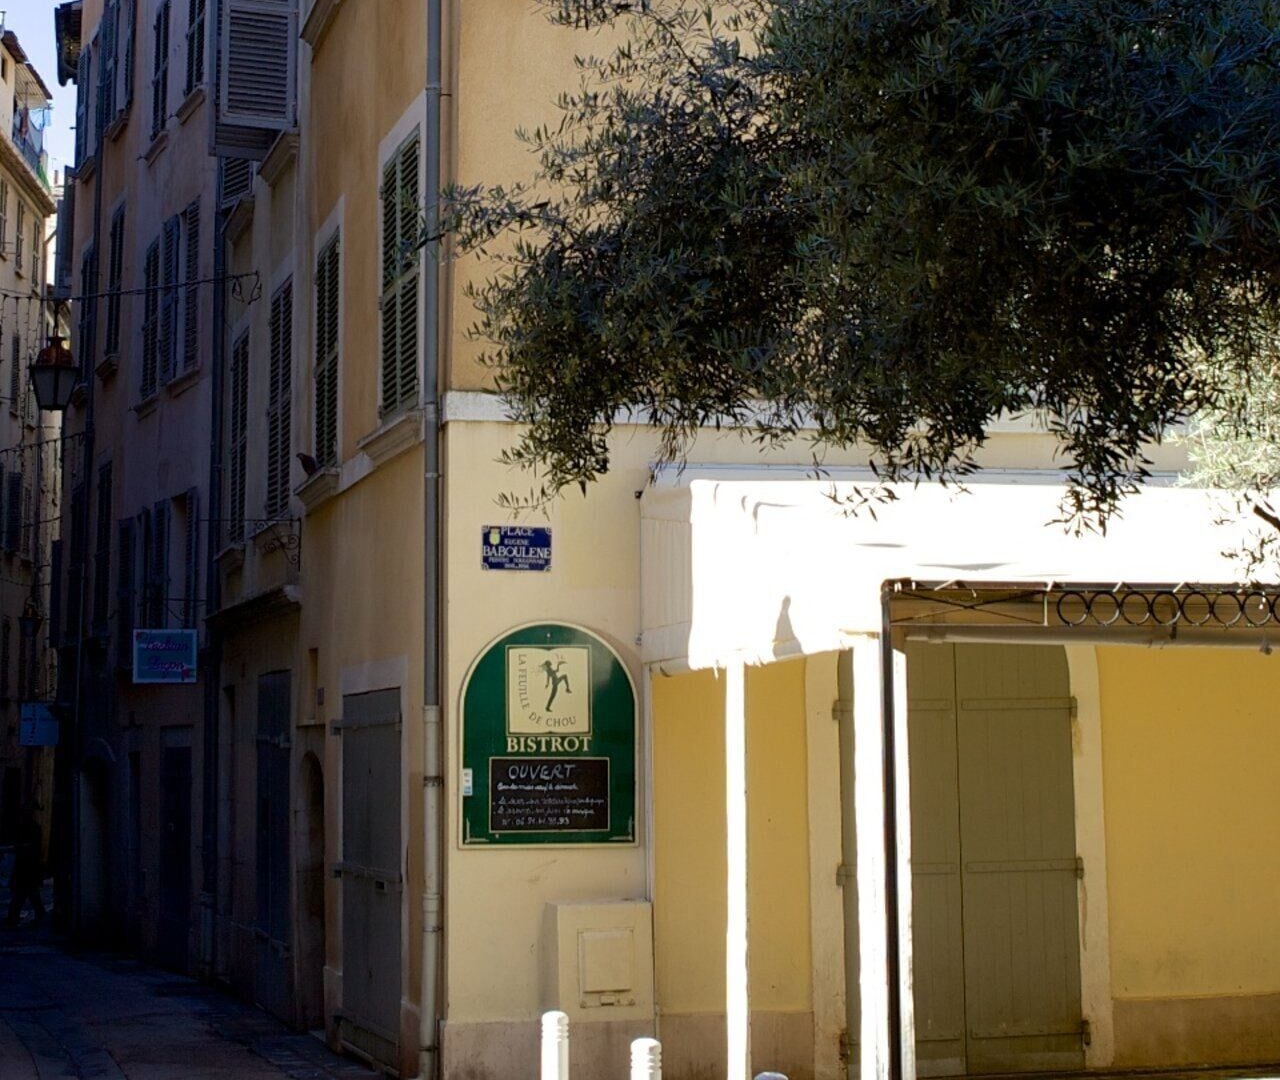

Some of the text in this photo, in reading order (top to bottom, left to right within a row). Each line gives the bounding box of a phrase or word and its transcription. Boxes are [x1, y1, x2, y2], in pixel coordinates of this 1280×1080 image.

[500, 526, 535, 537] PLACE
[518, 654, 577, 728] LA FEUILLE DE CHOU
[506, 736, 592, 753] BISTROT
[508, 764, 576, 781] OUVERT
